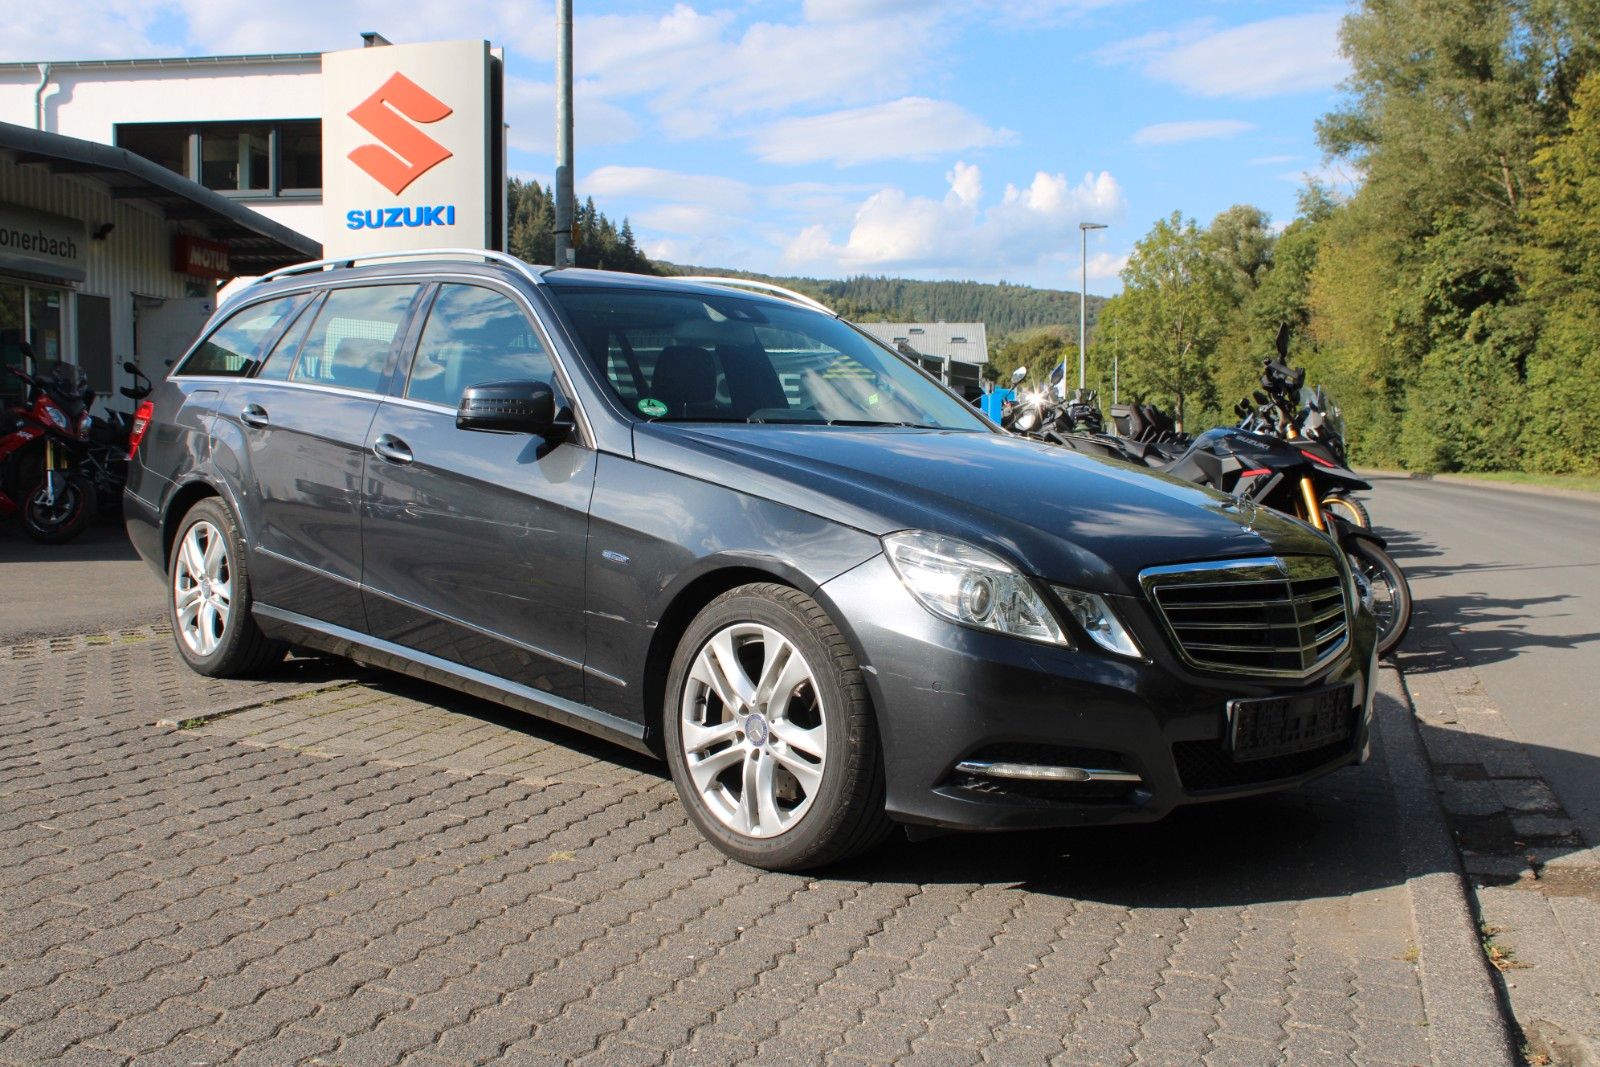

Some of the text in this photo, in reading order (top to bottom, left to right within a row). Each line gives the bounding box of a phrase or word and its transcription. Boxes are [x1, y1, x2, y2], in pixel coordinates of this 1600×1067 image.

[346, 205, 455, 230] SUZUKI
[0, 228, 76, 259] onerbach
[190, 245, 229, 271] MOTUL
[1235, 435, 1270, 449] SUZUKI
